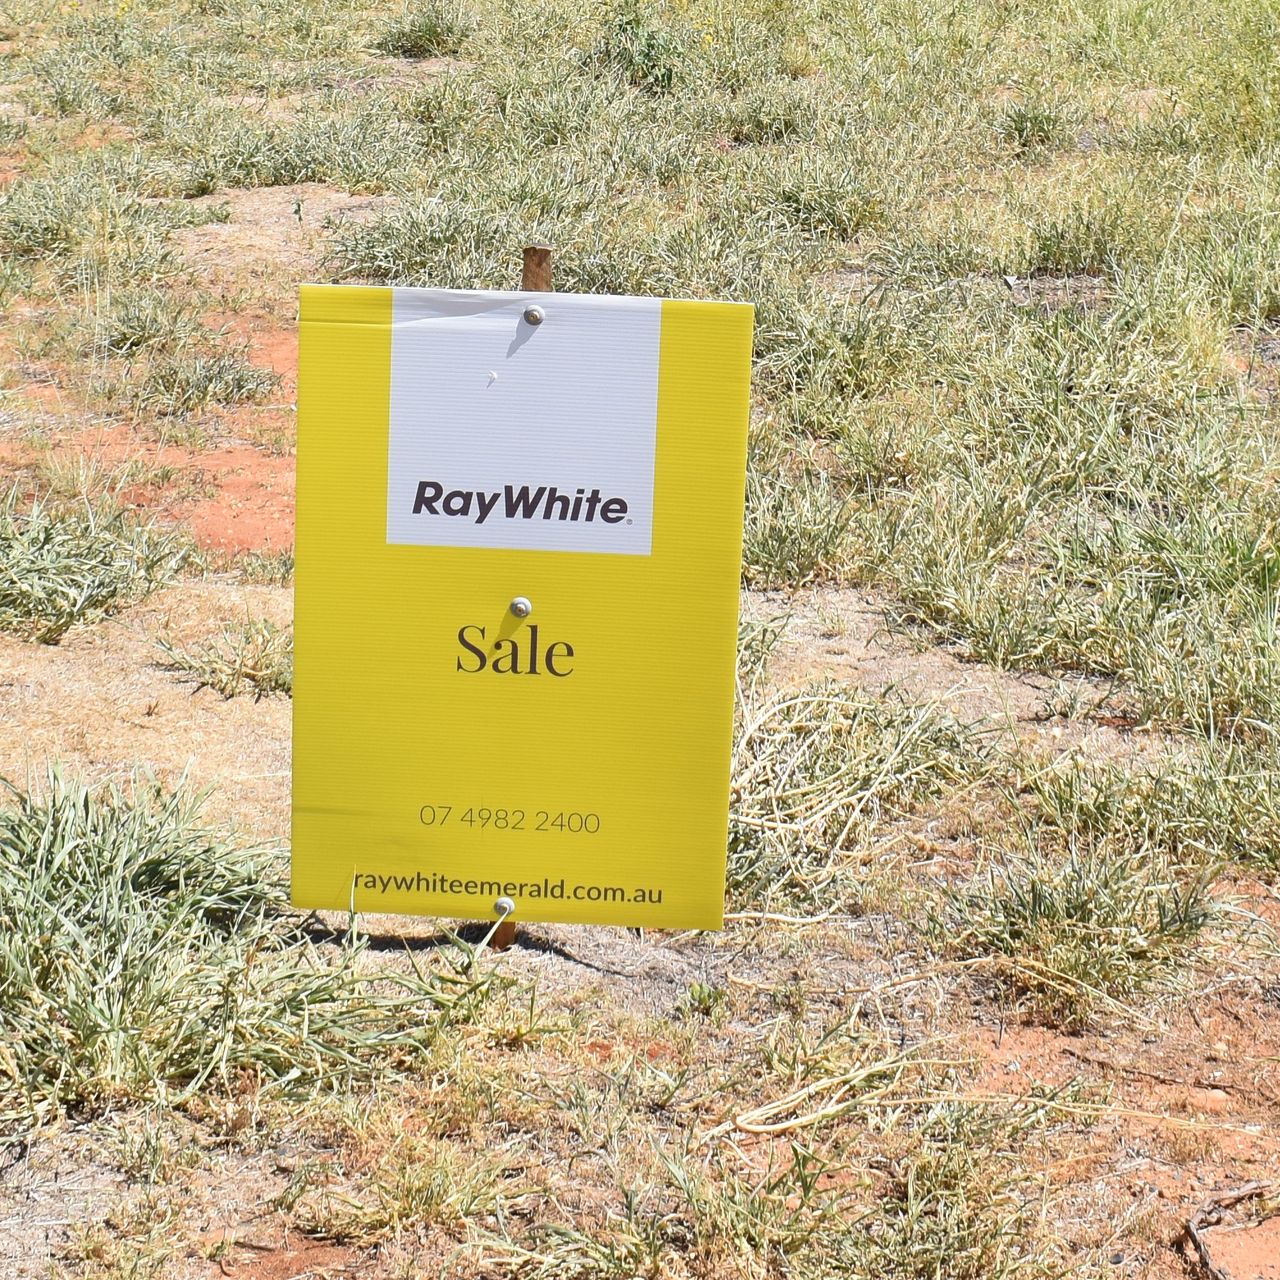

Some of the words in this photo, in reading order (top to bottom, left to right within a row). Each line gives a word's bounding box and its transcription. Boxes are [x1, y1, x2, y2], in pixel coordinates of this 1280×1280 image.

[456, 624, 575, 677] Sale
[420, 805, 452, 825] 07
[460, 807, 525, 830] 4982
[535, 811, 600, 833] 2400
[354, 871, 663, 904] raywhiteemerald.com.au
